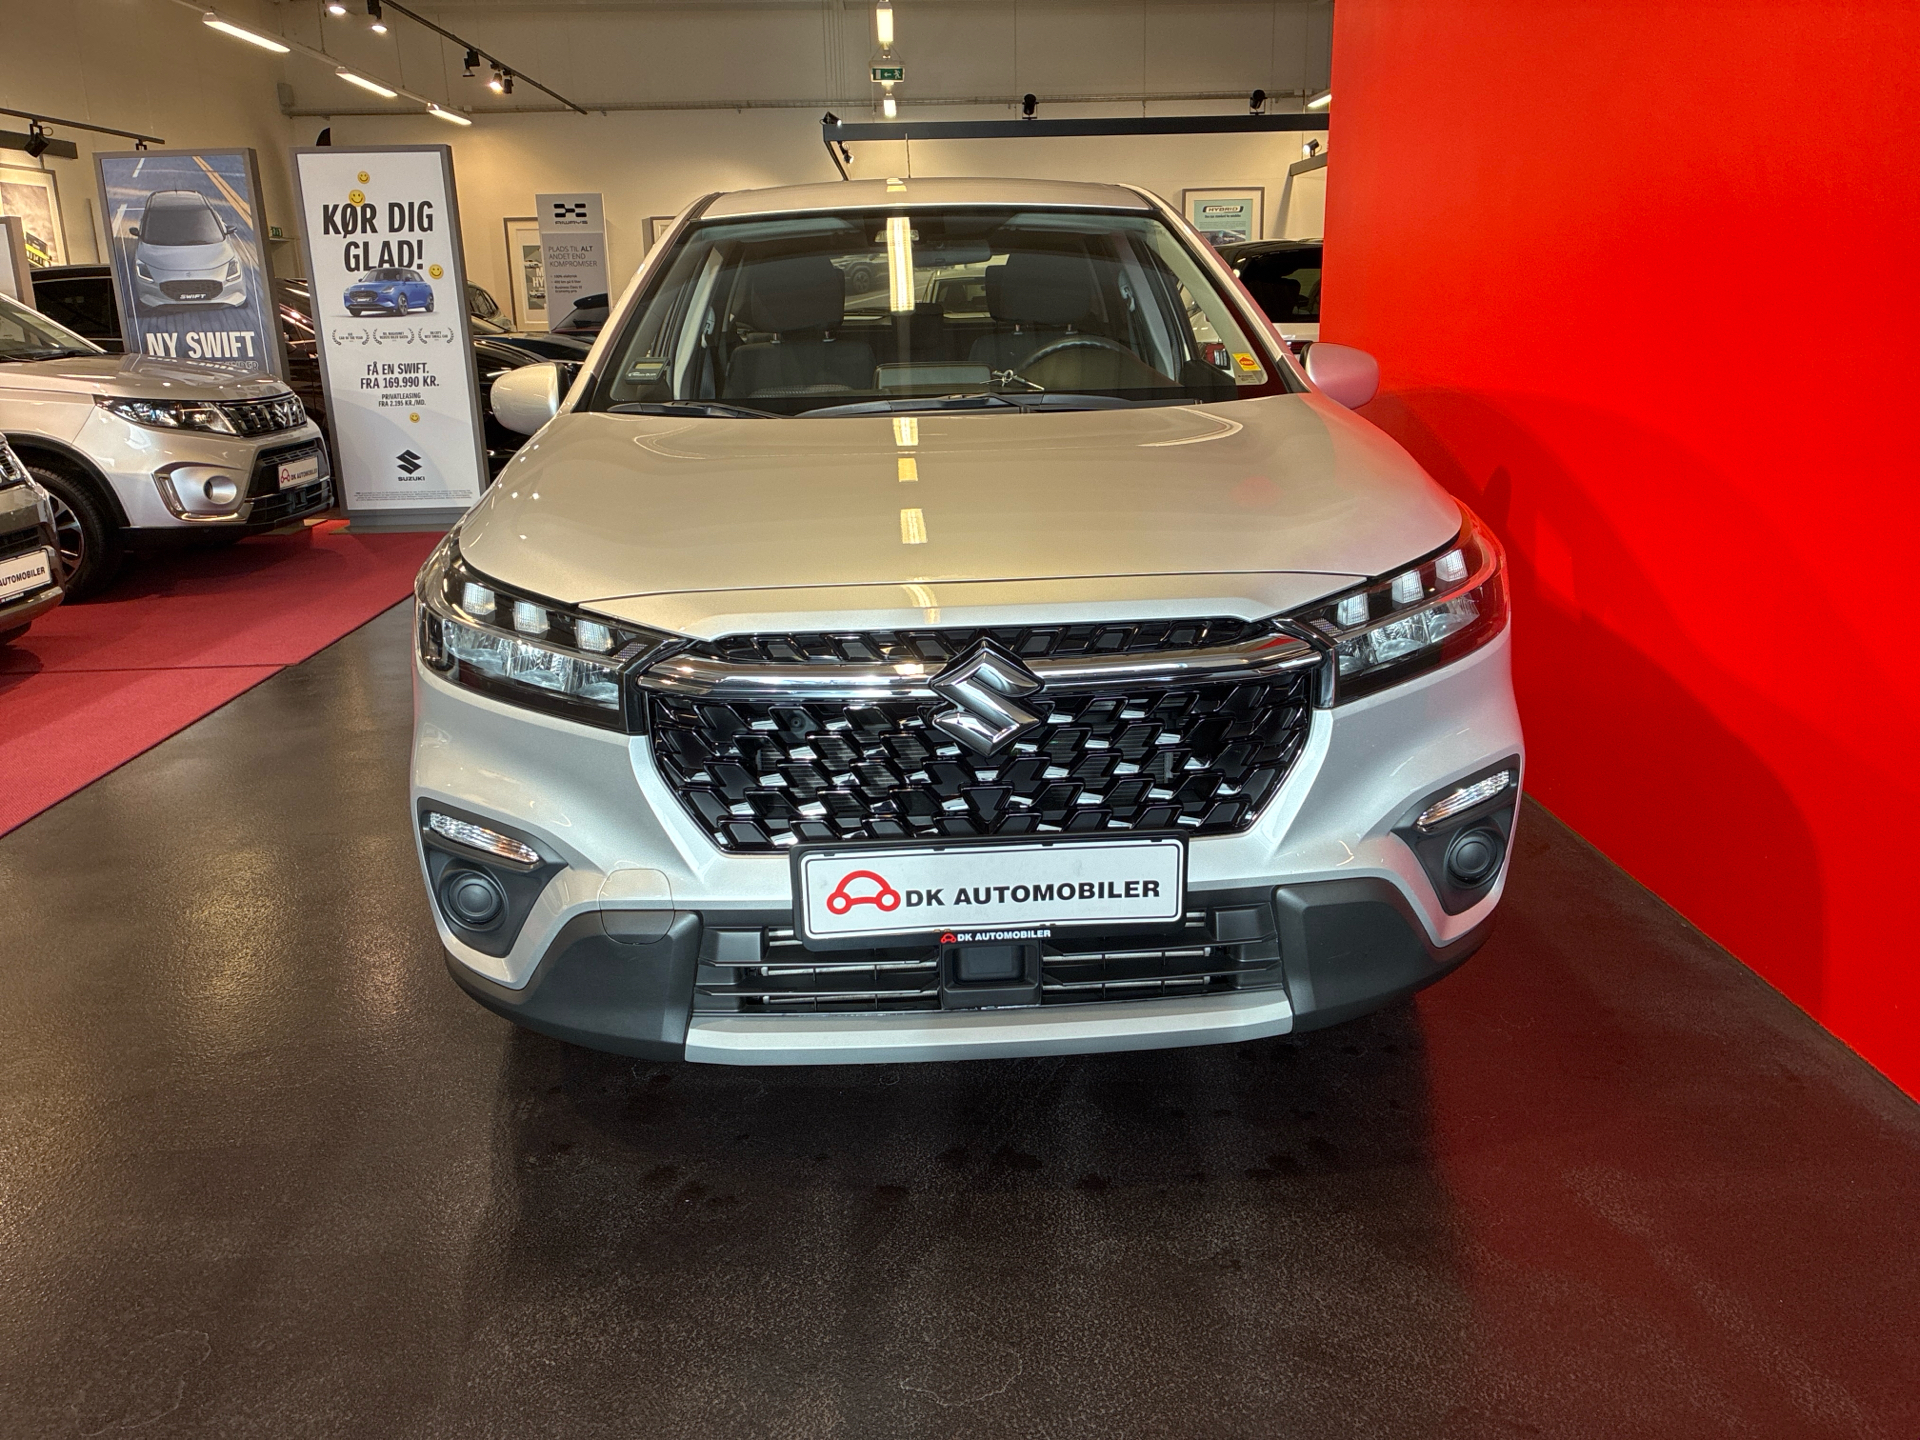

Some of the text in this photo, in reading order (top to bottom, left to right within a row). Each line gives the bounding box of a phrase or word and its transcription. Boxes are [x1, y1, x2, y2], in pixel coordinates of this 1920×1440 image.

[323, 201, 433, 239] KØR DIG
[344, 239, 424, 273] GLAD!
[146, 331, 255, 359] NY SWIFT
[367, 361, 429, 376] FÅ EN SWIFT.
[360, 375, 440, 389] FRA 169.990 KR.
[378, 400, 389, 408] FRA
[381, 392, 421, 401] PRIVATLEASING
[0, 566, 46, 587] AUTOMOBILER
[906, 880, 1161, 908] DK AUTOMOBILER
[957, 929, 1051, 942] DK AUTOMOBILER
